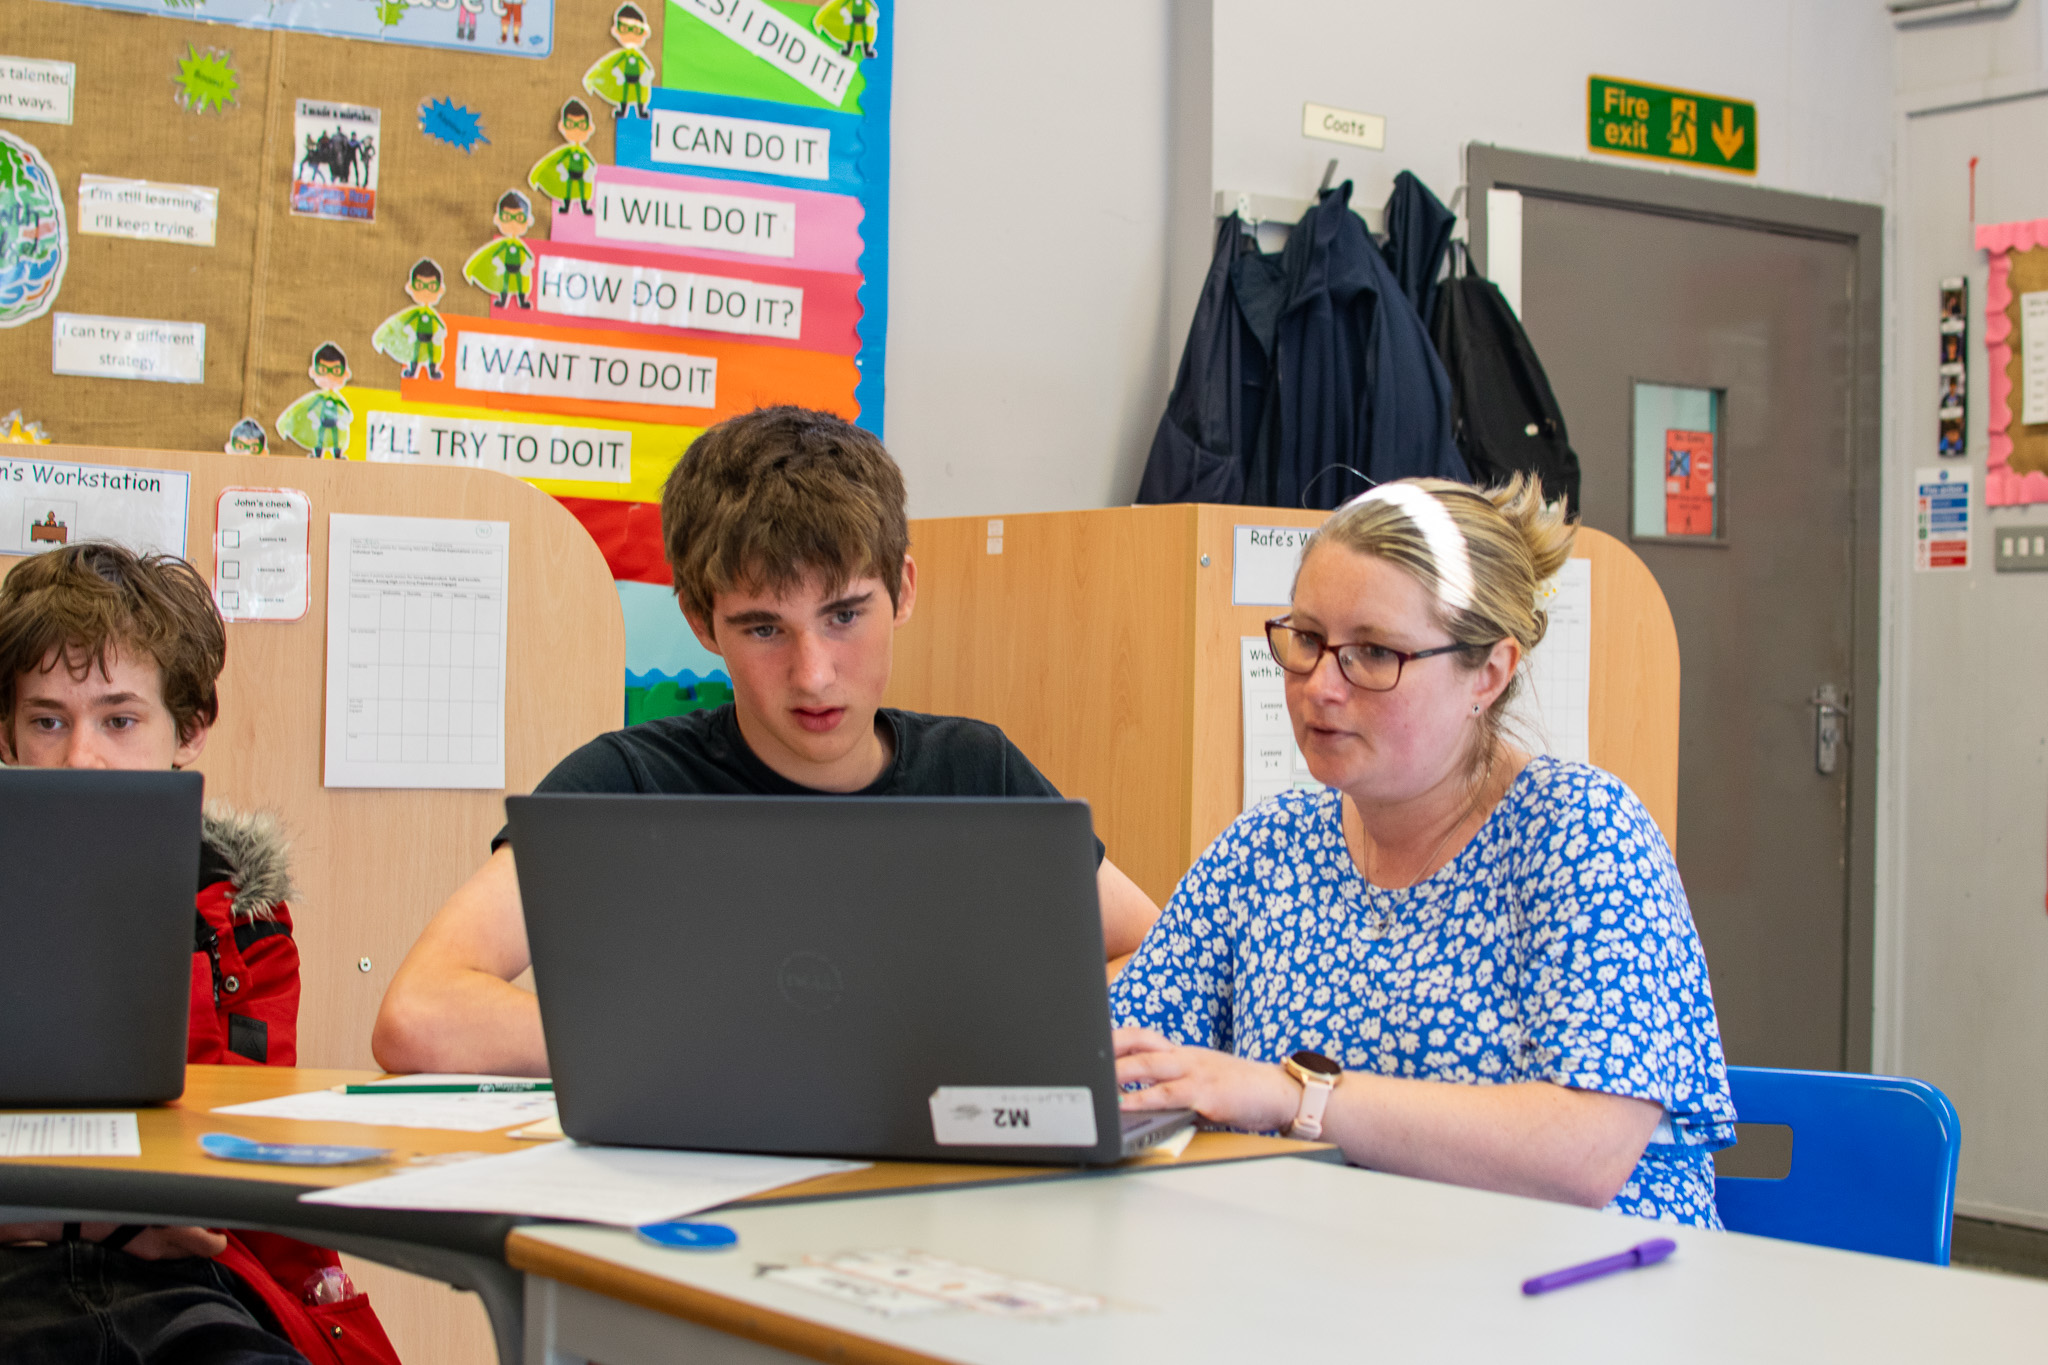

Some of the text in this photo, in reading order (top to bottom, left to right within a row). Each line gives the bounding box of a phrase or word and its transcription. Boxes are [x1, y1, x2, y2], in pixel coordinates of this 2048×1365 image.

[742, 10, 754, 32] I
[757, 20, 807, 64] DID
[810, 54, 846, 92] IT!
[9, 66, 70, 86] talented
[17, 95, 57, 111] ways.
[1603, 85, 1650, 119] Fire
[1323, 113, 1366, 137] Coats
[1603, 120, 1649, 150] exit
[655, 122, 818, 165] I CAN DO IT
[90, 187, 205, 213] I'm still learning.
[95, 214, 198, 239] I'll keep trying.
[603, 195, 778, 239] I WILL DO IT
[542, 269, 794, 327] HOW DO I DO IT?
[70, 326, 96, 339] can
[100, 327, 121, 342] try
[124, 331, 132, 340] a
[136, 326, 195, 346] different
[462, 344, 713, 394] I WANT TO DO IT
[369, 424, 420, 456] I'LL
[430, 428, 488, 459] TRY
[497, 433, 538, 464] TO
[32, 464, 161, 493] Workstation
[234, 498, 292, 509] John's check
[245, 511, 254, 519] in
[1250, 528, 1294, 547] Rafe's
[1250, 666, 1272, 678] with
[1260, 749, 1282, 757] Lessons
[992, 1107, 1031, 1129] M2
